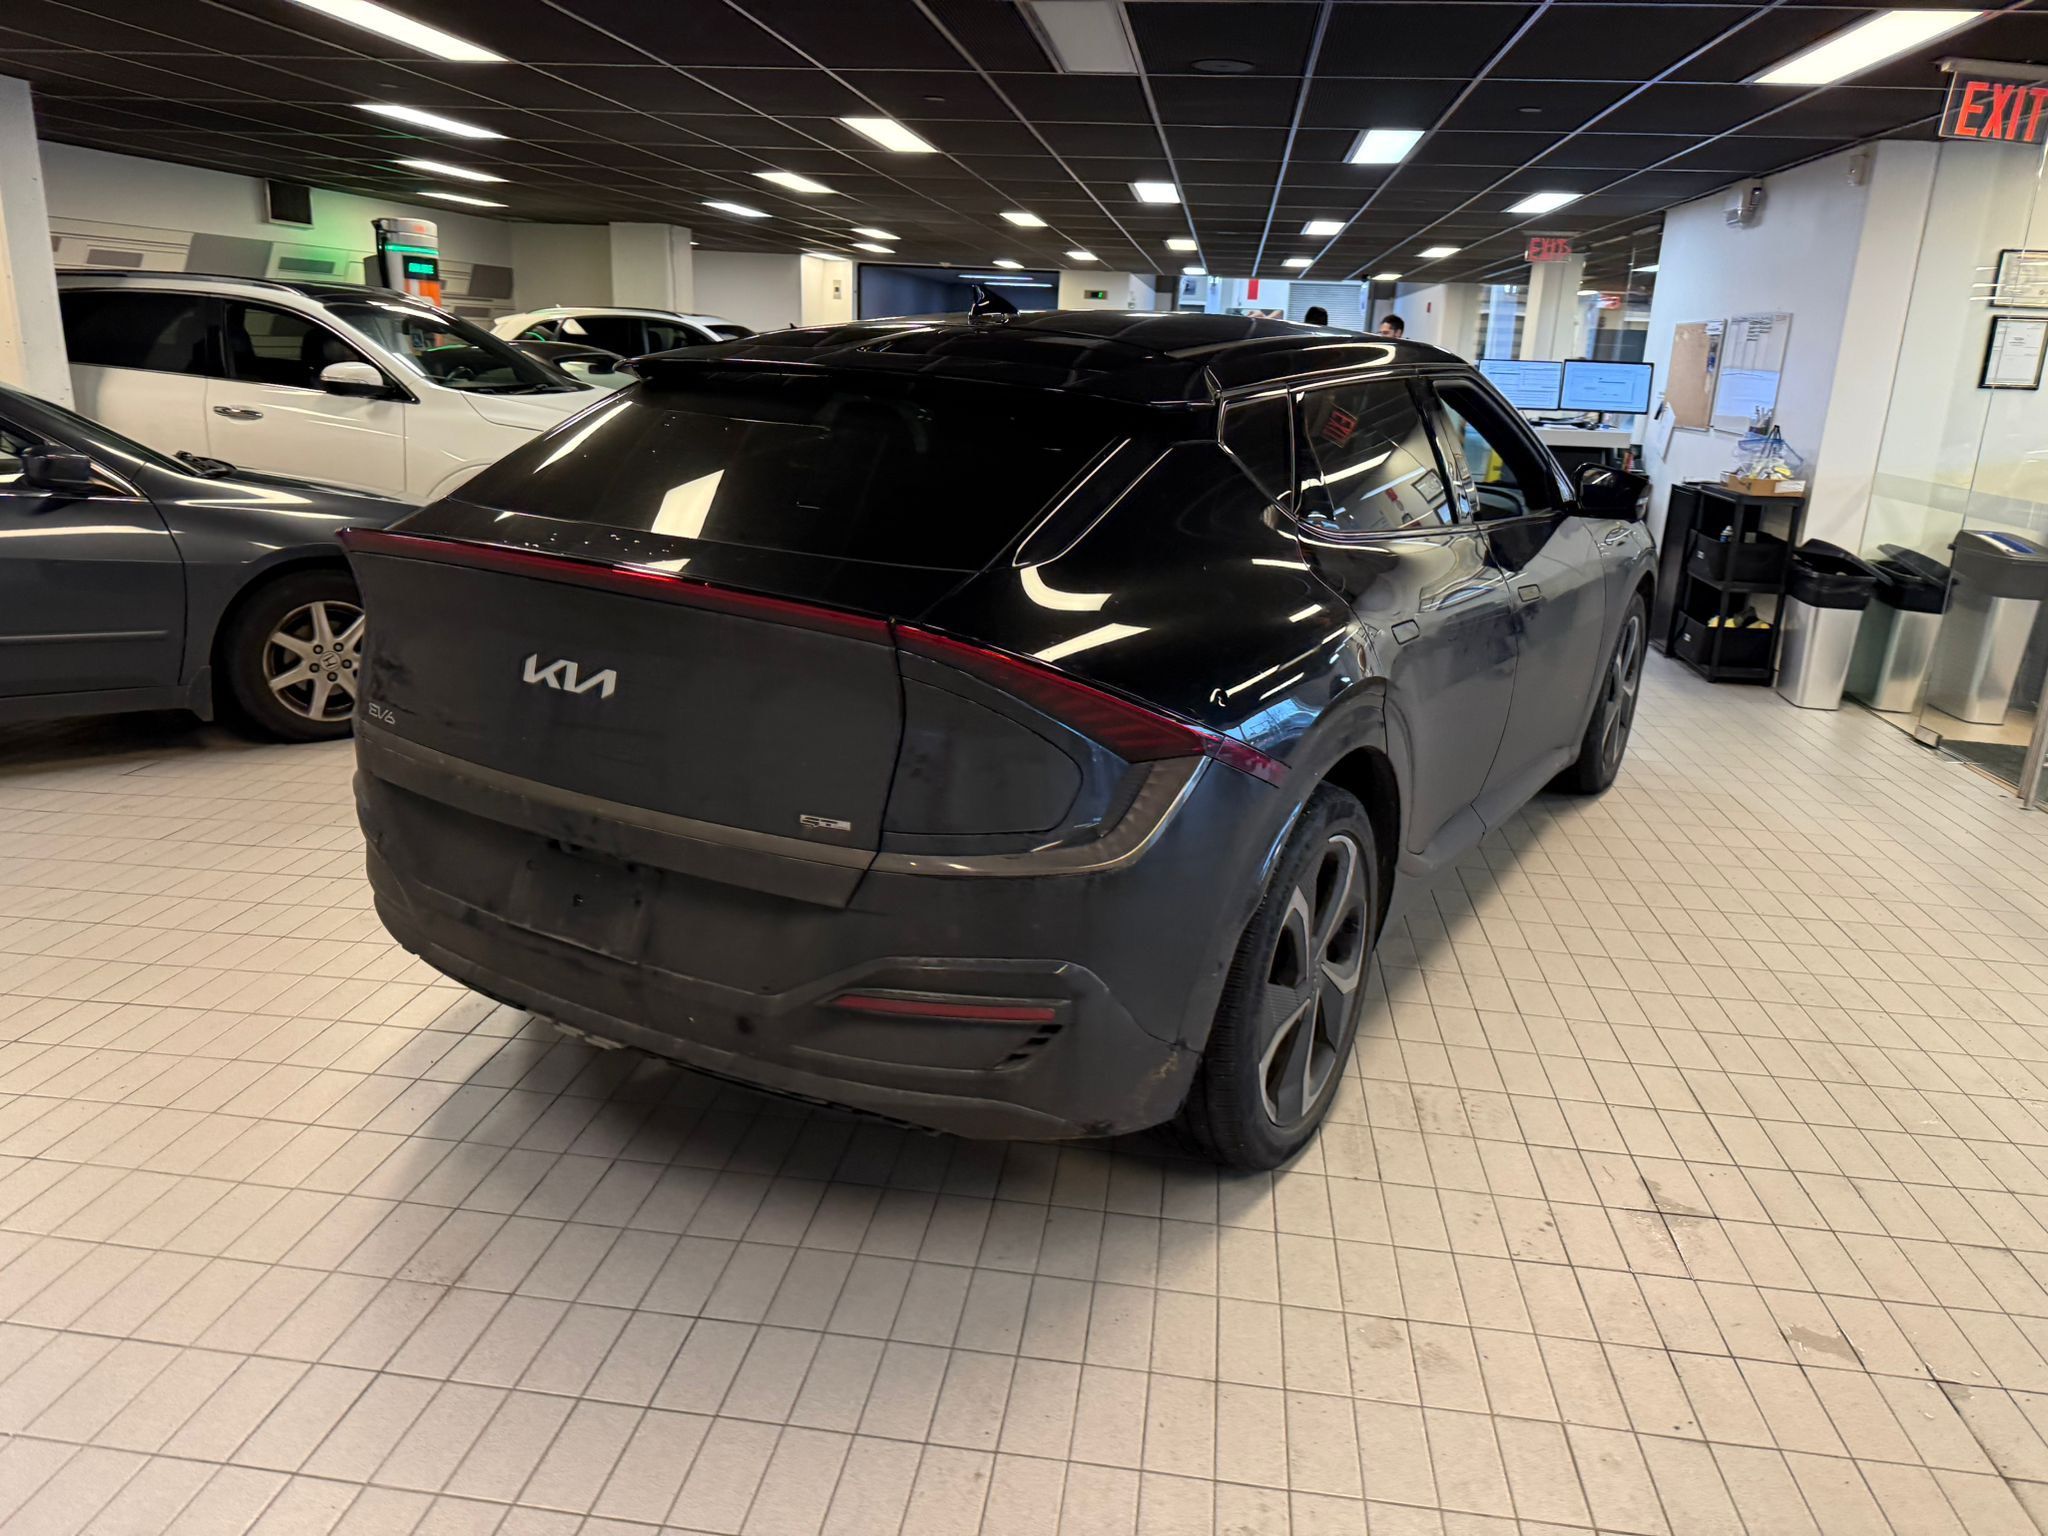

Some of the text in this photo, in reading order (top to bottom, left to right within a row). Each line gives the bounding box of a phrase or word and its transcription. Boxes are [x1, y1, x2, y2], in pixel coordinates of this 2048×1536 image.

[1954, 81, 2048, 142] EXIT
[523, 653, 617, 699] KIA
[368, 702, 396, 725] EV6
